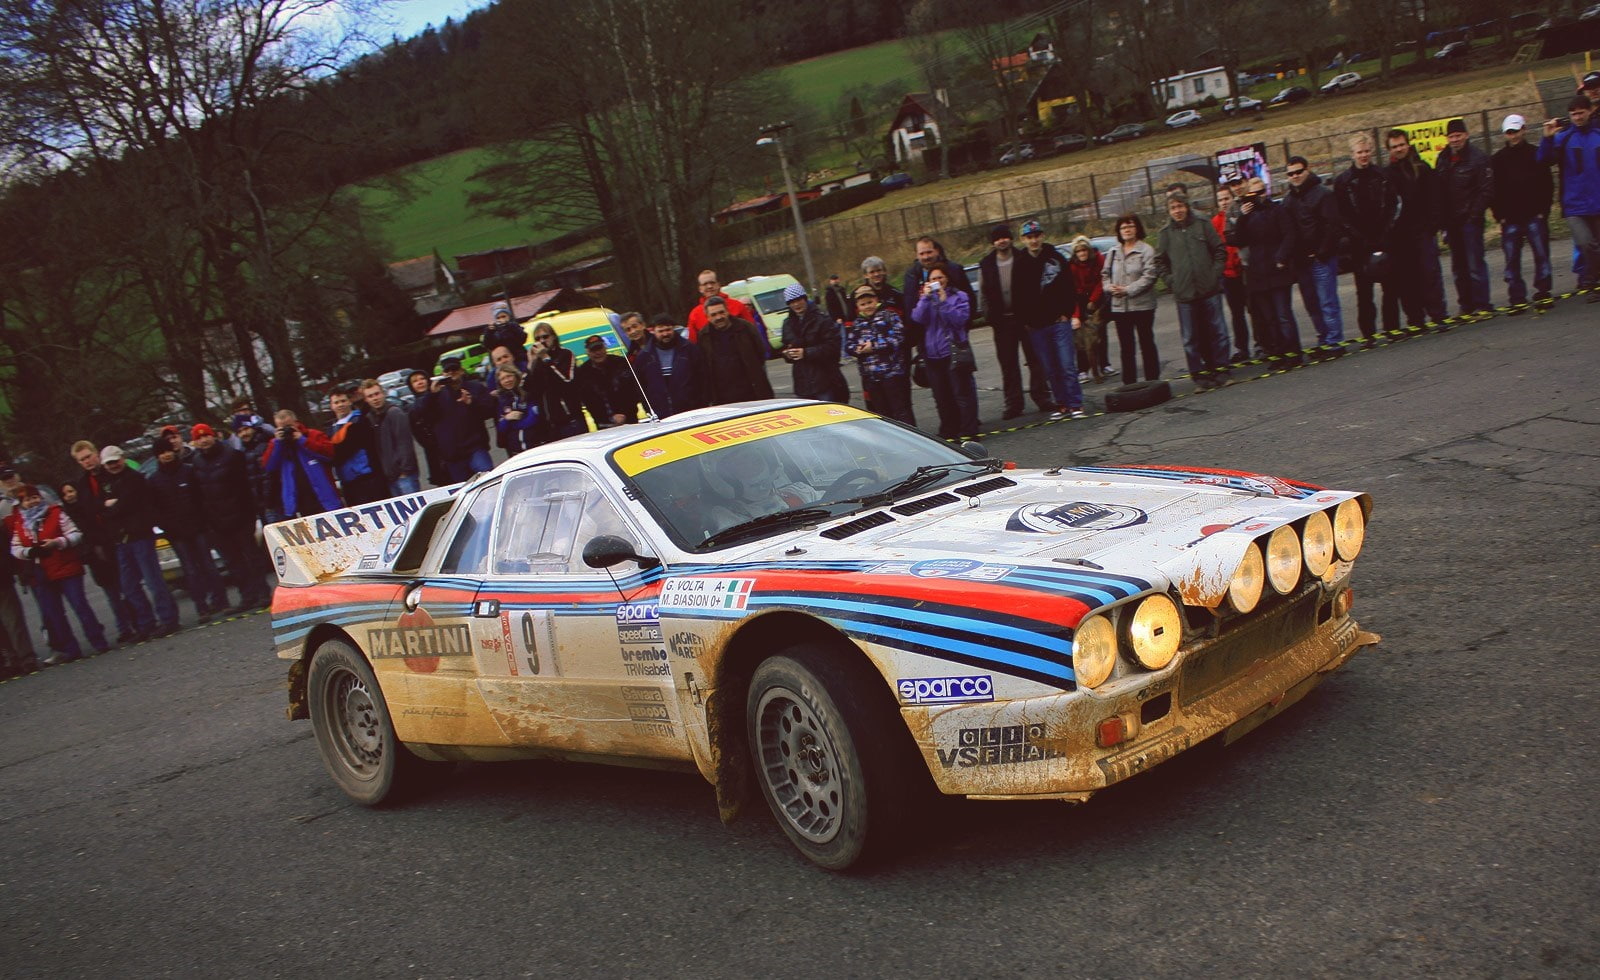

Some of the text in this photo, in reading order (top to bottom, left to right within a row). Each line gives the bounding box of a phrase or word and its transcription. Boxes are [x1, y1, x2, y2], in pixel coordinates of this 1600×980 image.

[1409, 123, 1447, 141] ATOVÁ
[691, 414, 805, 445] PIRELLI
[677, 580, 704, 591] VOLTA
[674, 595, 711, 606] BIASION
[370, 628, 469, 656] MARTINI
[619, 627, 658, 642] speedline
[522, 612, 540, 675] 9
[622, 646, 667, 660] brembo
[900, 677, 992, 703] sparco
[962, 727, 1042, 744] OLIO
